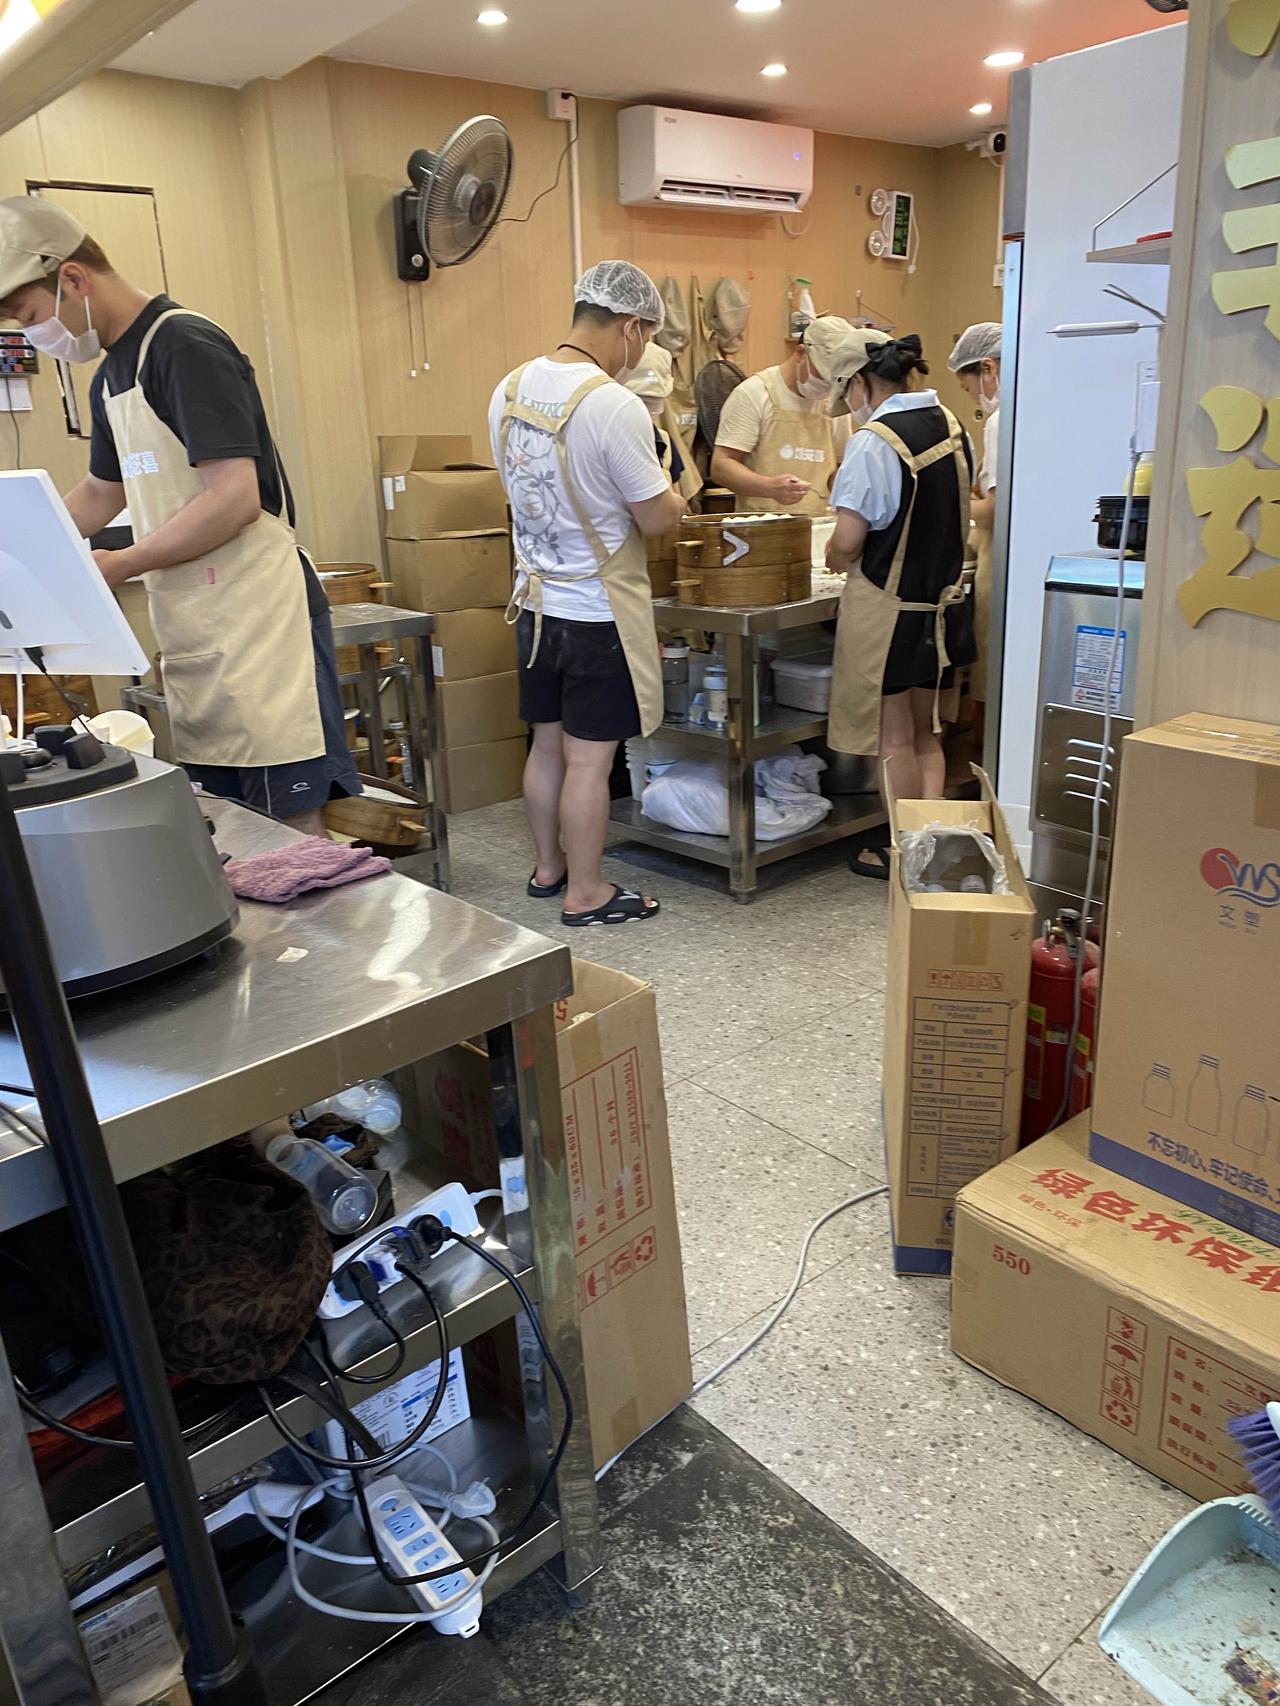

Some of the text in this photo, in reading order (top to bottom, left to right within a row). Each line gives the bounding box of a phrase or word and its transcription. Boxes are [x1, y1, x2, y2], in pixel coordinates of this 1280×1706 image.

[1147, 1131, 1280, 1205] 不忘初心、牢记使命、
[992, 1243, 1032, 1276] 550
